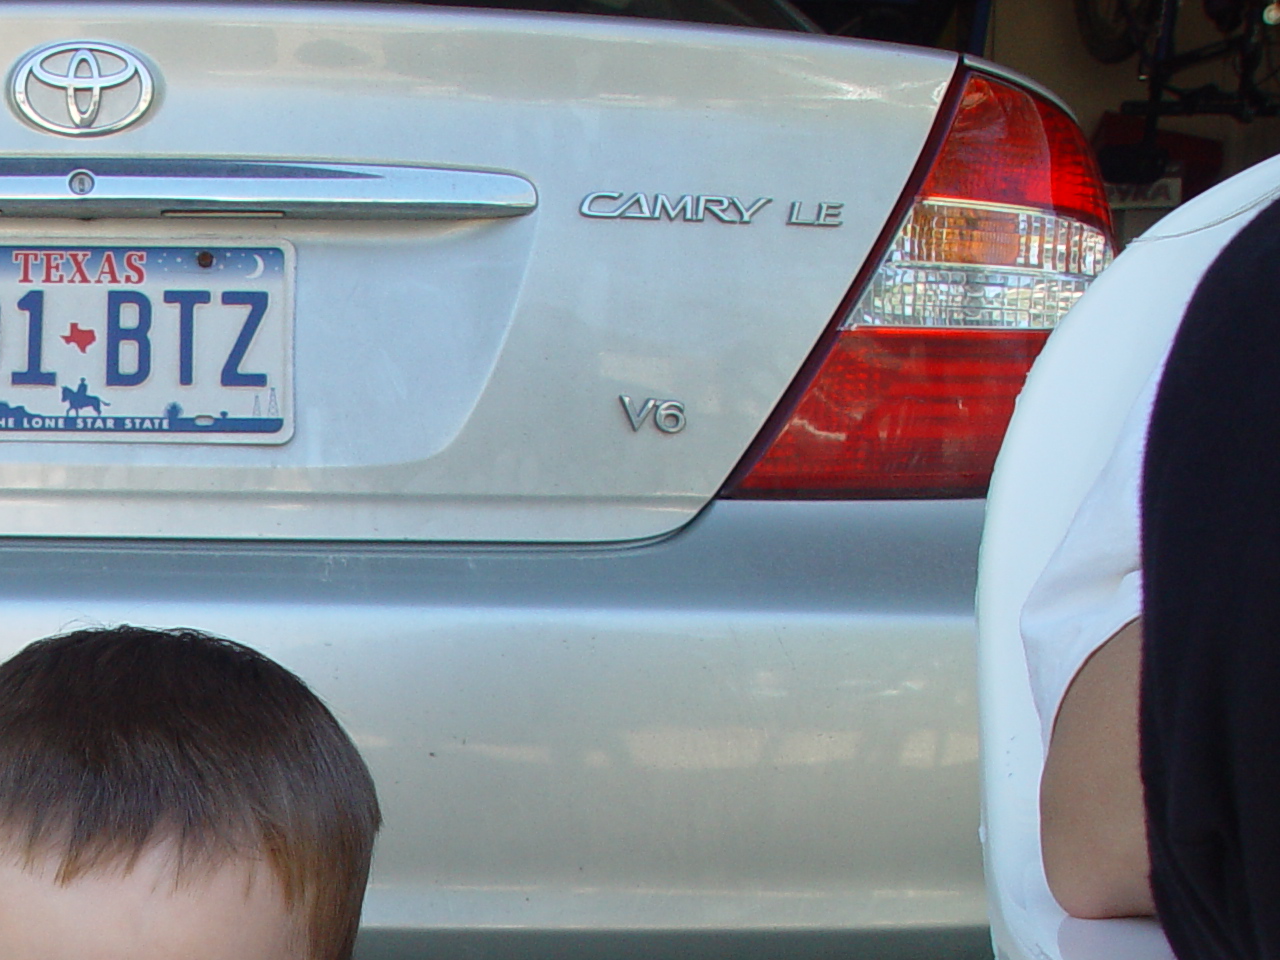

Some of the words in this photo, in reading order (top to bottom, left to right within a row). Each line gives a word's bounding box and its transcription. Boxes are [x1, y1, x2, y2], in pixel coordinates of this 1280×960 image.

[579, 191, 773, 224] CAMRY
[786, 201, 845, 226] LE
[13, 250, 147, 285] TEXAS
[105, 290, 269, 387] BTZ
[22, 417, 65, 429] LONE
[76, 417, 116, 430] STAR
[124, 418, 170, 430] STATE
[619, 394, 687, 434] V6
